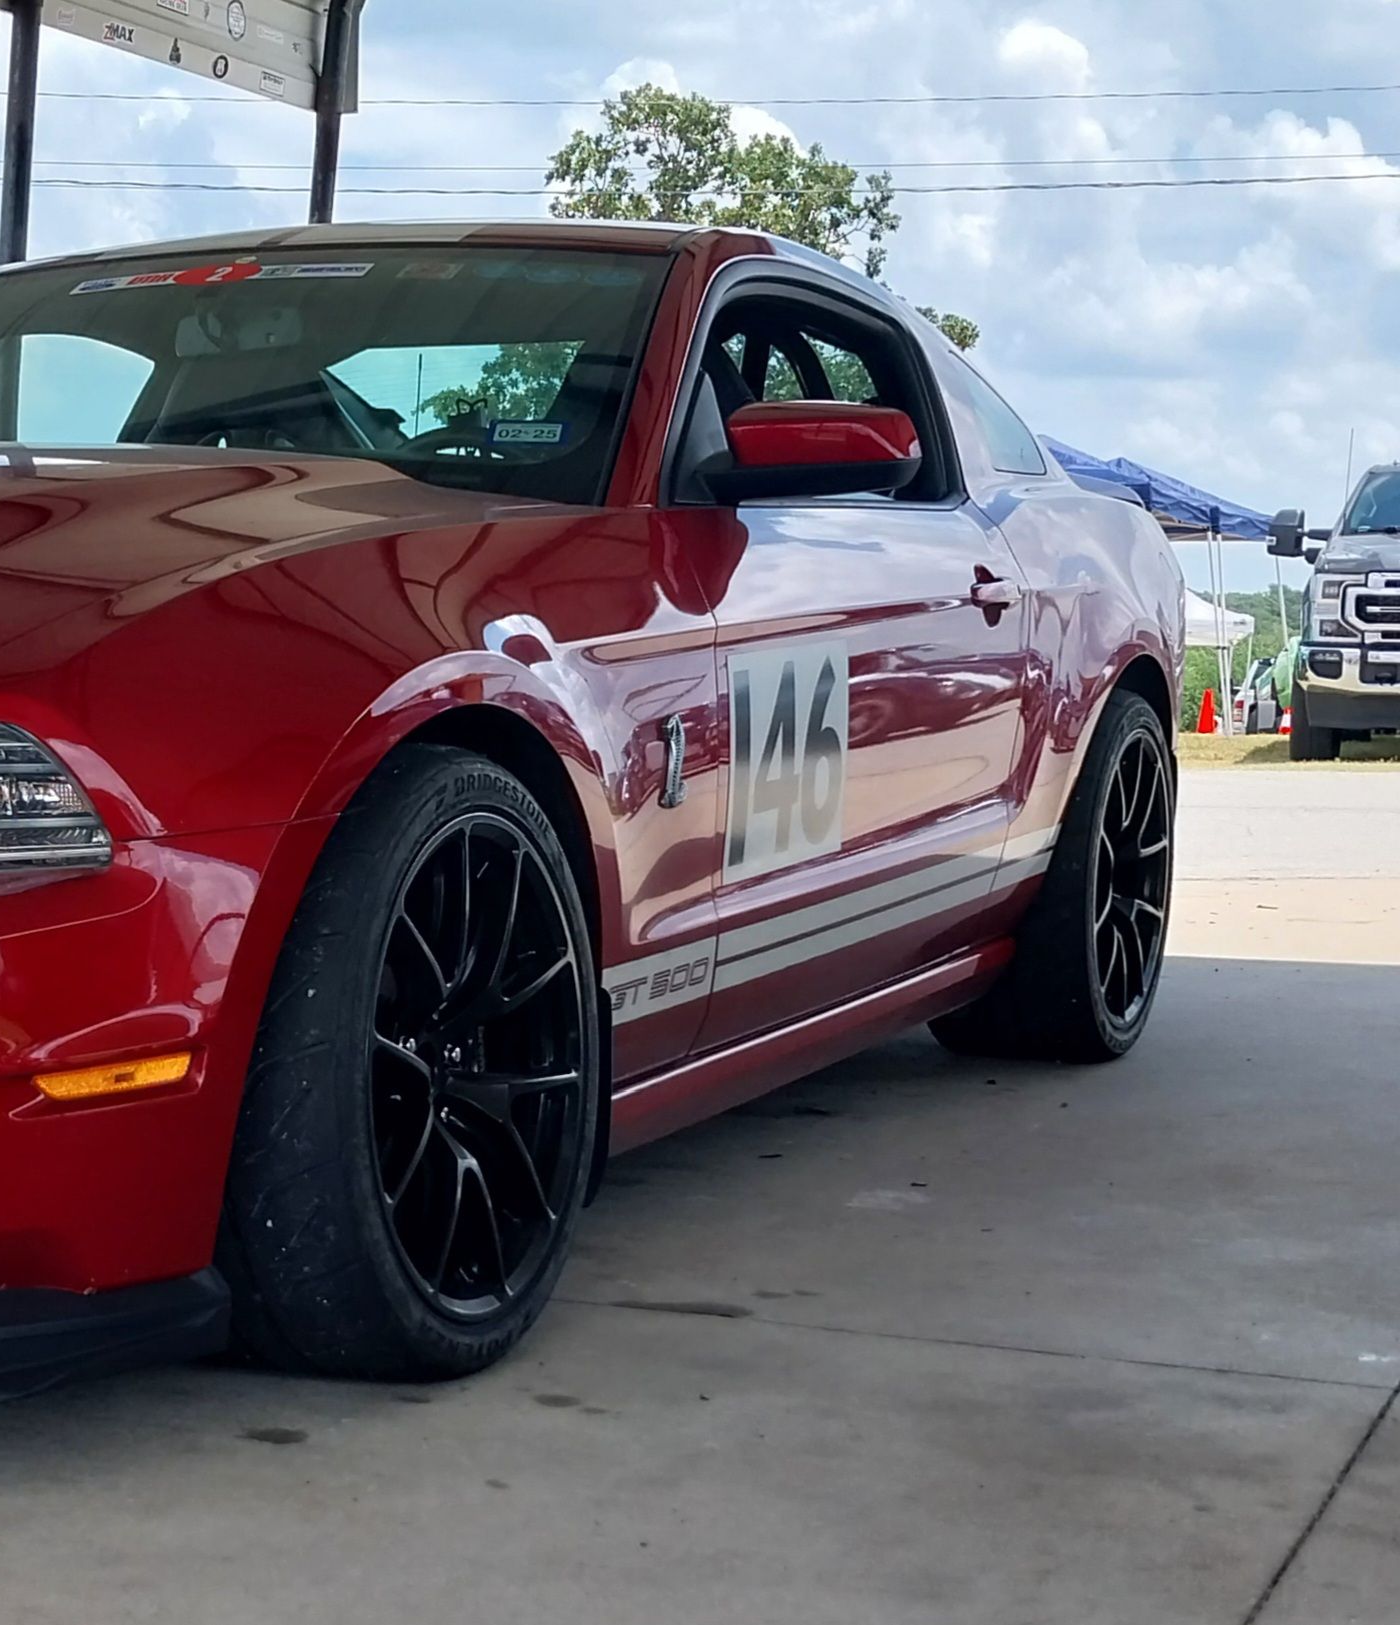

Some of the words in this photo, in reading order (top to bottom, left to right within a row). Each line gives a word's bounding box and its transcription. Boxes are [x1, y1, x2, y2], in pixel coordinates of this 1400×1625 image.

[206, 266, 233, 282] 2
[728, 655, 843, 868] 146
[453, 772, 551, 838] BRIDGESTONE
[648, 956, 709, 1001] 500
